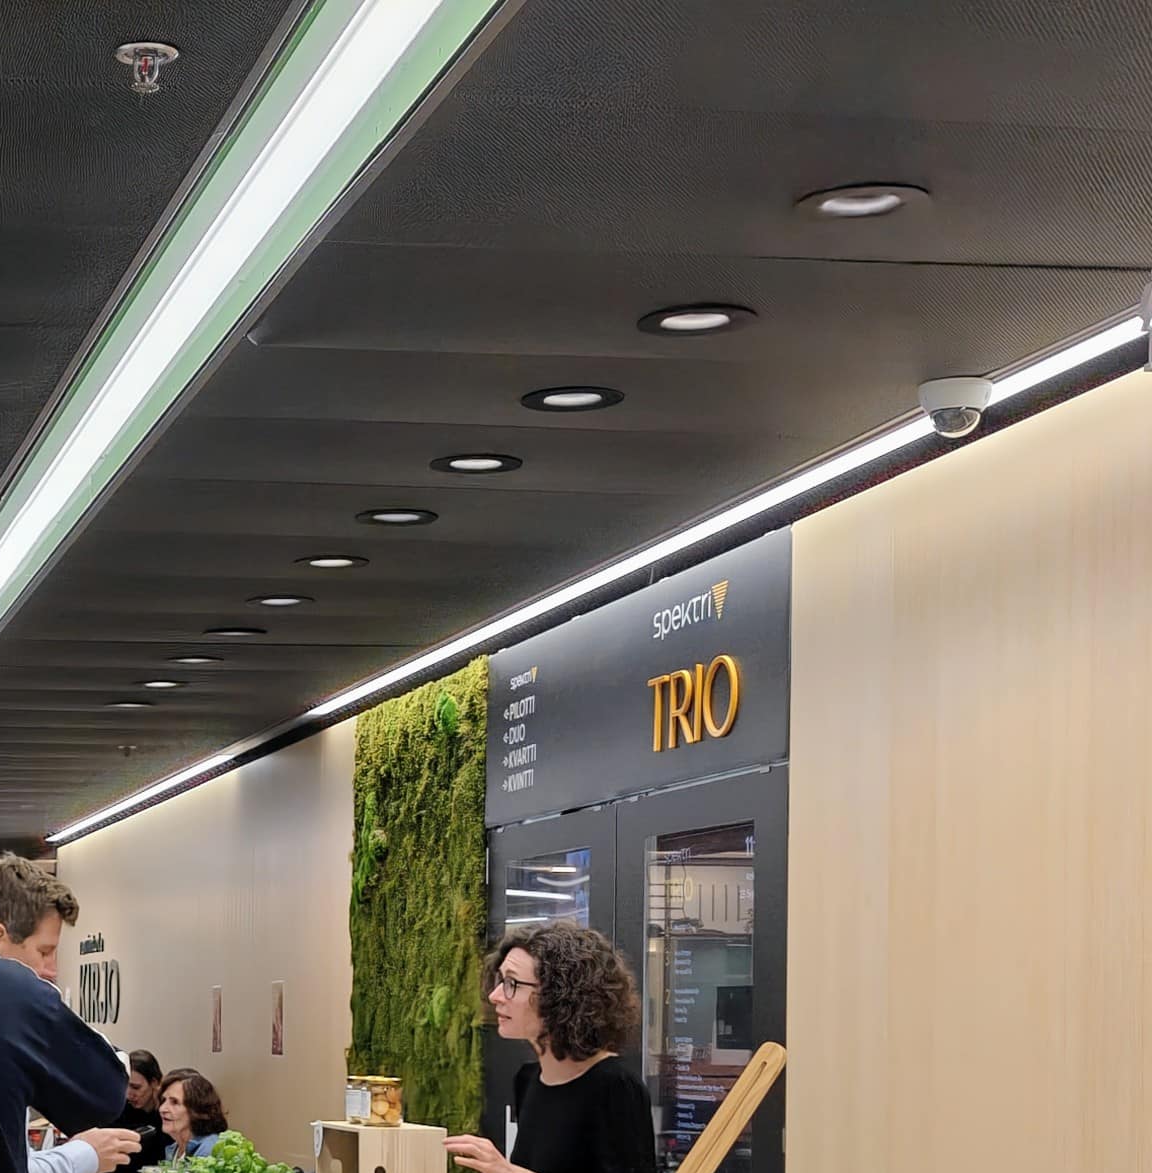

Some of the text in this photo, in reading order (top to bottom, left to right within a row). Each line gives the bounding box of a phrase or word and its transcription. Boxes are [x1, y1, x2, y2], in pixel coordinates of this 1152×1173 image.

[652, 590, 712, 641] spektri
[509, 695, 535, 721] PILOTTI
[647, 655, 740, 752] TRIO
[508, 723, 526, 745] DUO
[508, 744, 537, 769] KVARTTI
[79, 959, 120, 1024] KIRJO
